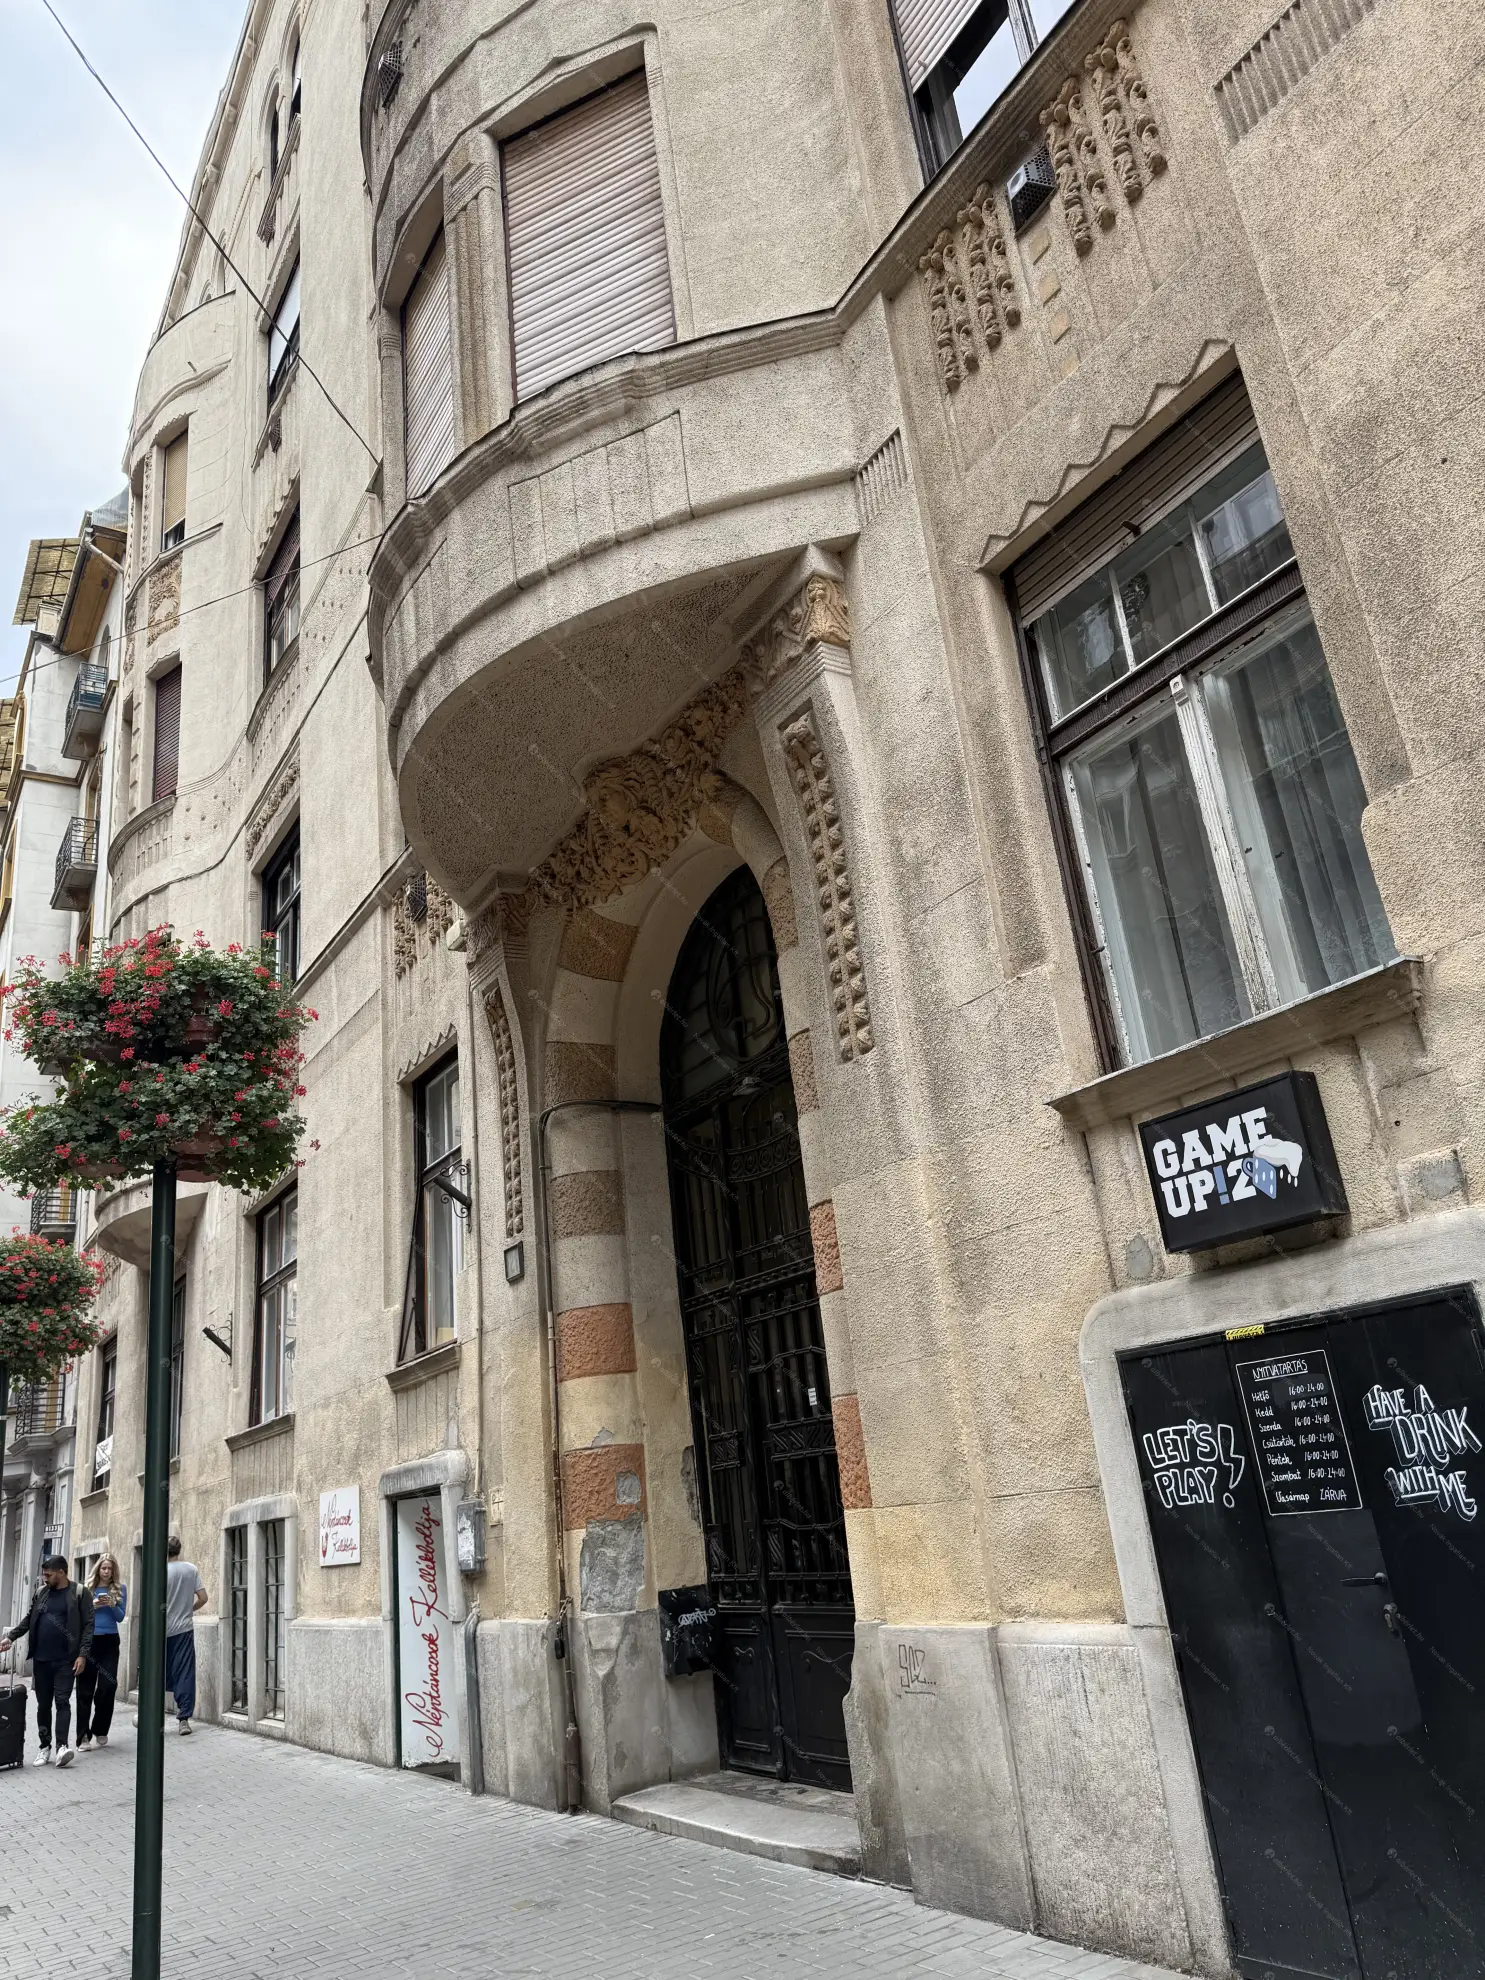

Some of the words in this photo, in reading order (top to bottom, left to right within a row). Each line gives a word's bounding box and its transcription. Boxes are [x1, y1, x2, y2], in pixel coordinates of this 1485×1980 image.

[1152, 1106, 1271, 1179] GAME
[1252, 1359, 1308, 1379] NYITVATARTÁS
[1364, 1384, 1411, 1428] HAVE
[1414, 1384, 1434, 1414] A
[1392, 1406, 1482, 1468] DRINK
[1275, 1490, 1310, 1505] Vasárnap
[1319, 1486, 1347, 1501] ZÁRVA
[1385, 1466, 1440, 1504] WITH
[1438, 1470, 1477, 1519] ME
[410, 1498, 448, 1628] Kellékboltja
